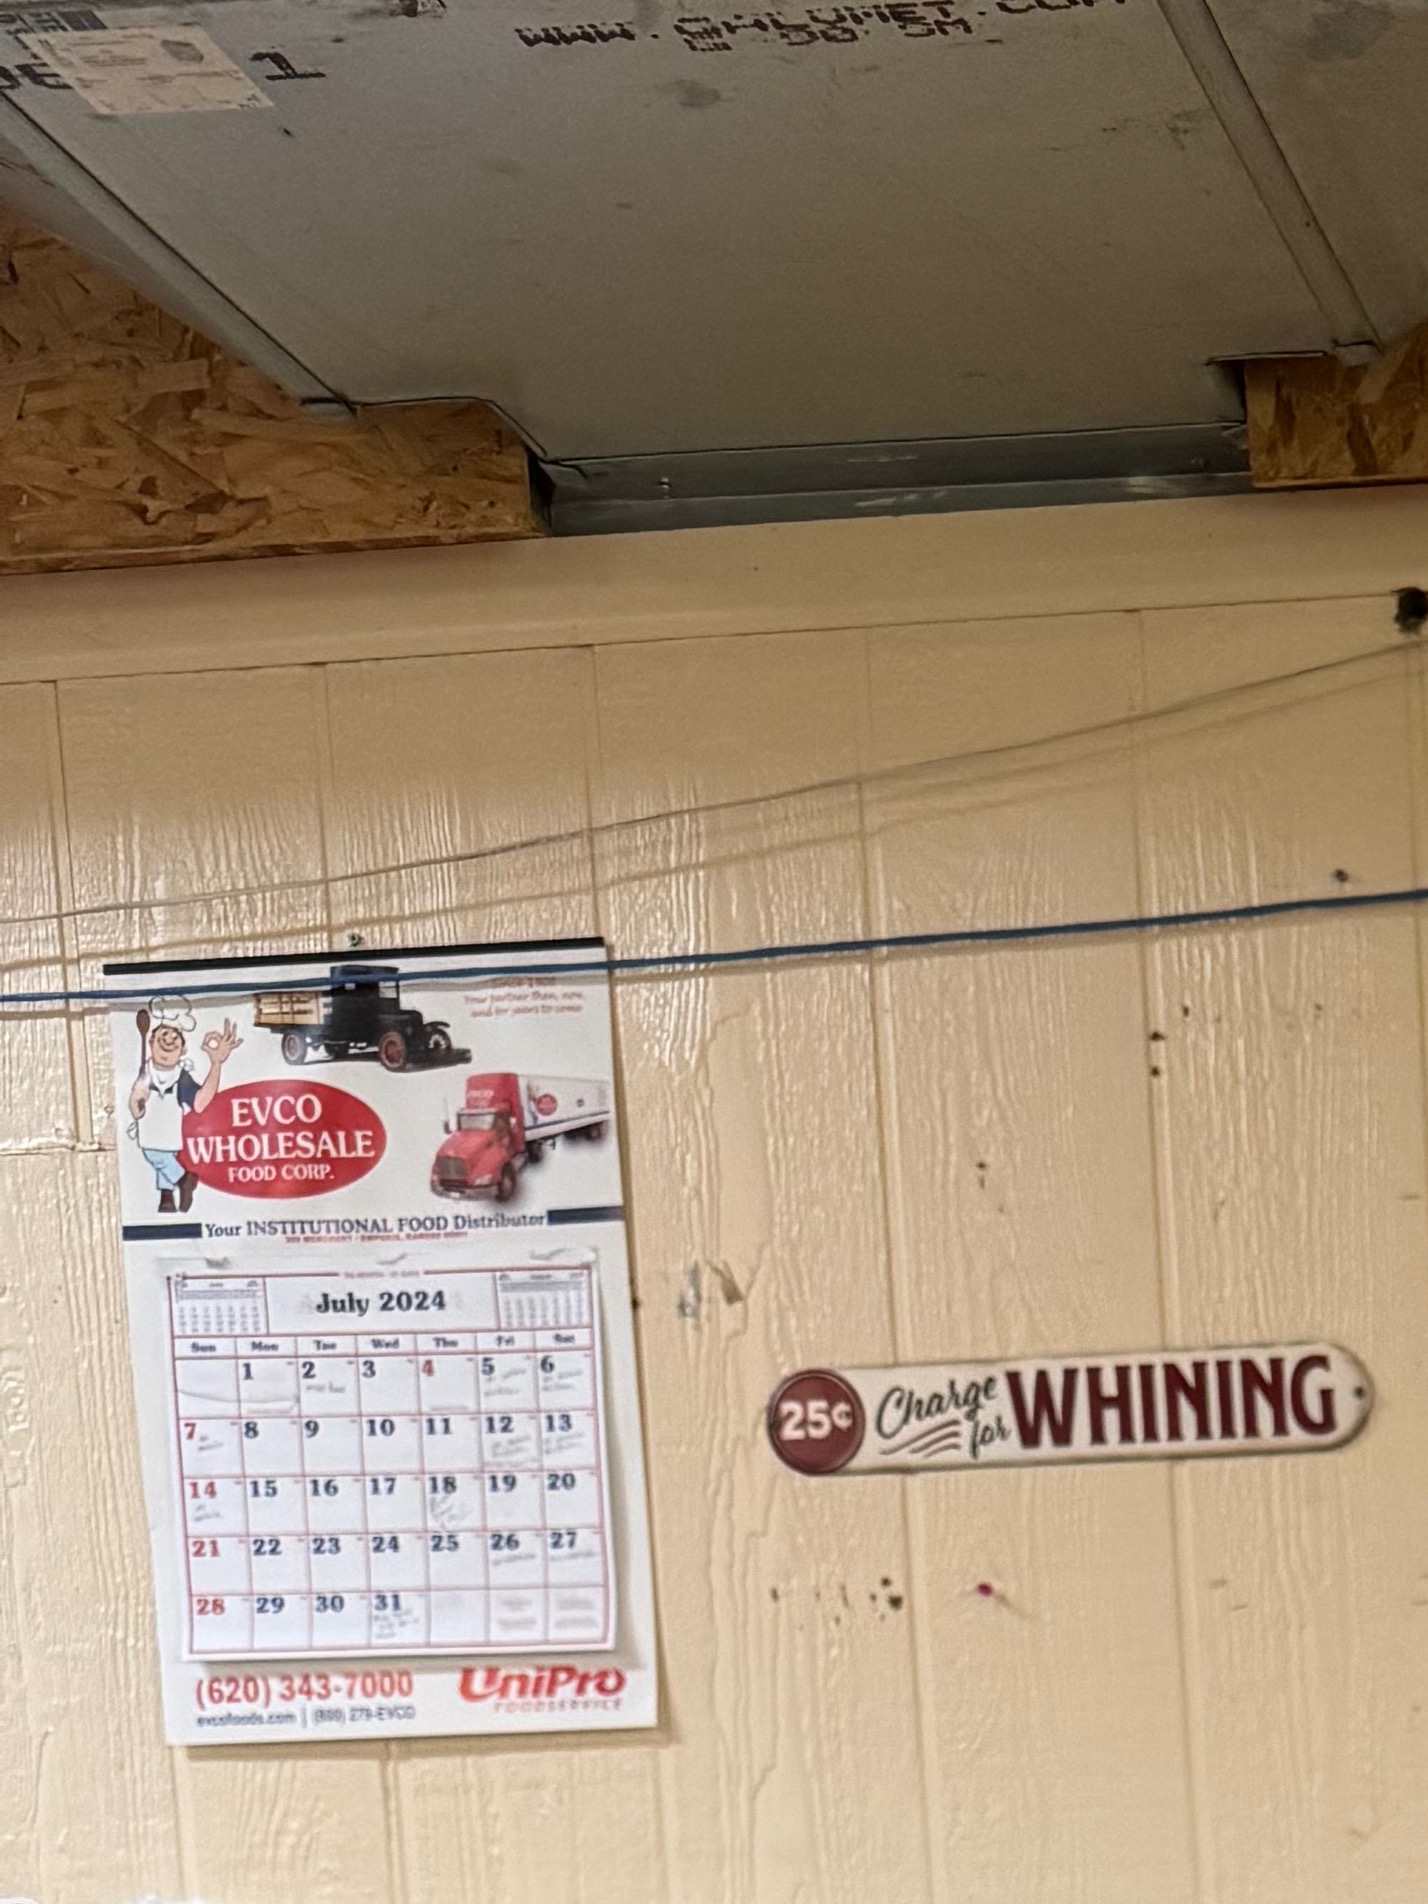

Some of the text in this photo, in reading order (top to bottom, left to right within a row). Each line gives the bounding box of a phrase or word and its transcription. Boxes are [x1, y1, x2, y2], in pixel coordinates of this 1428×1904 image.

[231, 1093, 322, 1128] EVCO
[186, 1129, 376, 1164] WHOLESALE
[227, 1162, 335, 1183] FOOD CORP.
[205, 1212, 547, 1238] Your INSTITUTIONAL FOOD Distributor
[315, 1289, 447, 1317] July 2024
[191, 1341, 217, 1353] Sun
[251, 1340, 280, 1352] Mon
[313, 1339, 338, 1351] Tue
[371, 1337, 400, 1350] Wed
[432, 1336, 459, 1348] Thu
[495, 1335, 515, 1347] Fri
[242, 1355, 556, 1380] 1 2 3 4 5 6
[779, 1353, 1338, 1460] 25¢ Charge for WHINING
[183, 1413, 573, 1441] 7 8 9 10 11 12 13
[188, 1472, 576, 1500] 14 15 16 17 18 19 20
[191, 1531, 578, 1558] 21 22 23 24 25 26 27
[196, 1593, 401, 1616] 28 29 30 31
[196, 1664, 627, 1711] (620) 343-7000 UniPro
